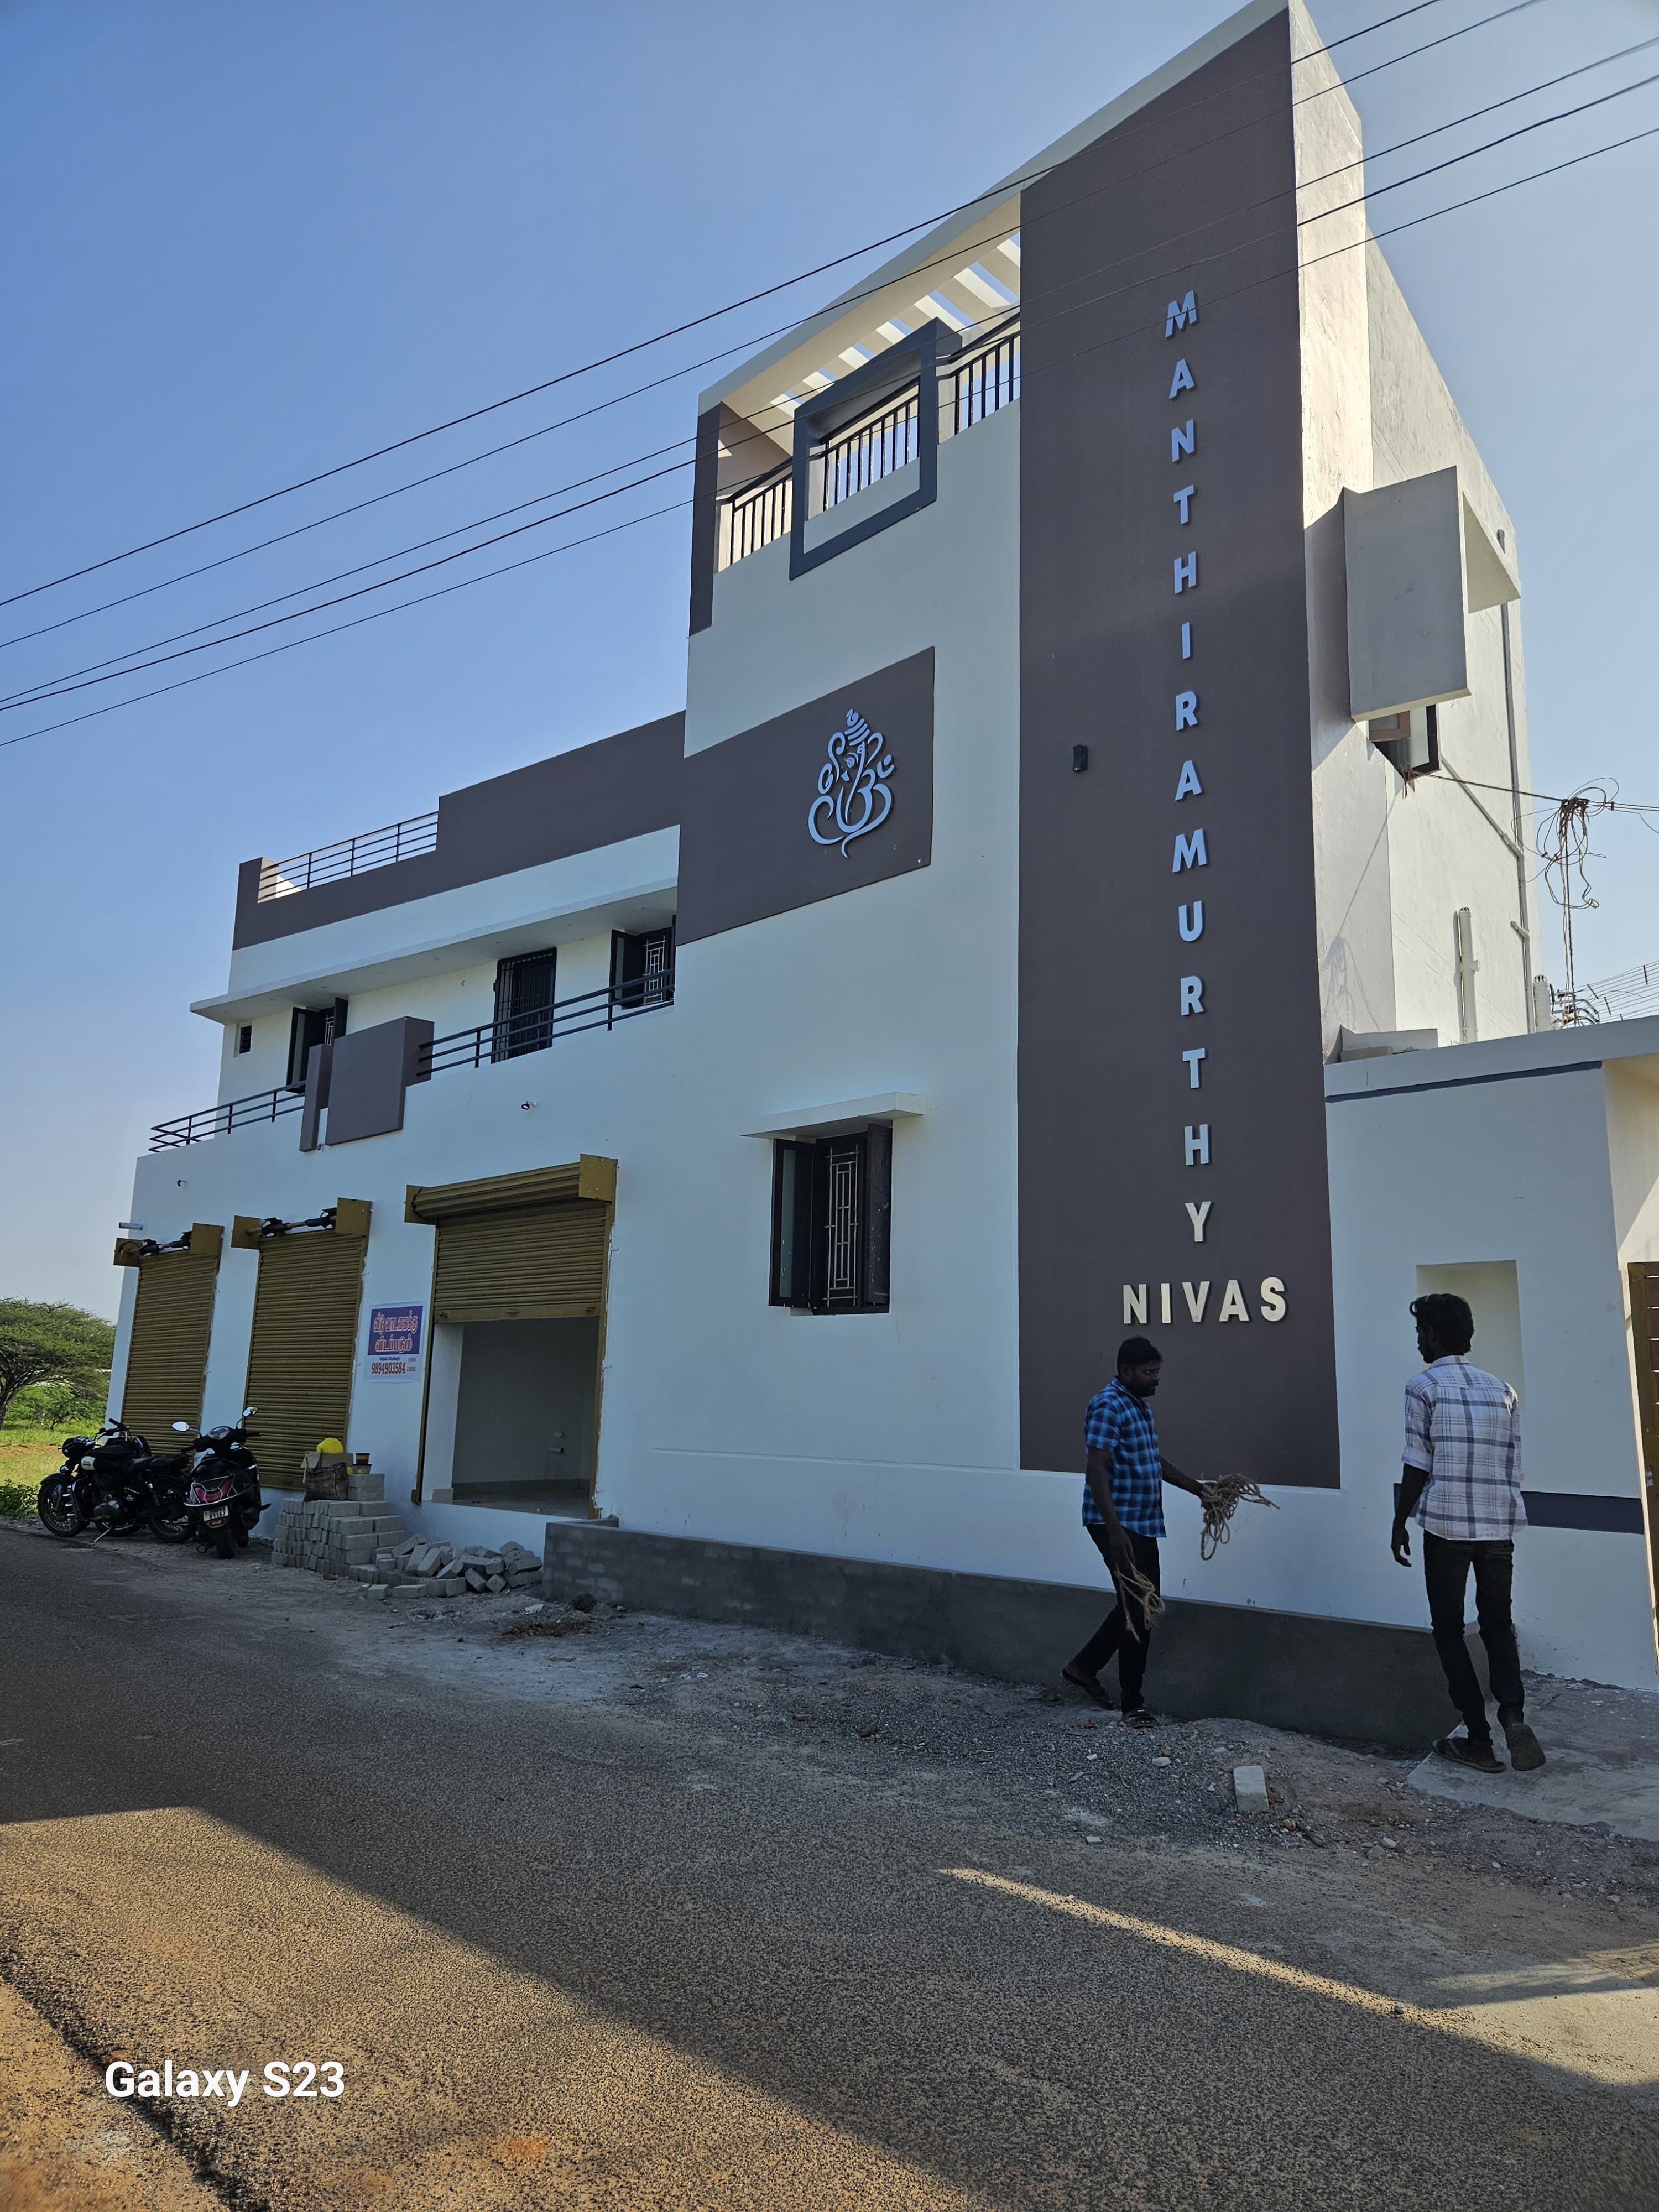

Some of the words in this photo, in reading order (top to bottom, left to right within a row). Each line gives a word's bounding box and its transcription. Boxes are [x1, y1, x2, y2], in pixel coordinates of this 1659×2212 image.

[1165, 290, 1212, 1242] MANTHIRAMURTHY
[1123, 1277, 1287, 1324] NIVAS
[373, 1311, 385, 1334] வீடு
[385, 1310, 418, 1333] வாடகைக்கு
[375, 1333, 413, 1353] விடப்படும்
[371, 1362, 405, 1374] 9894903584
